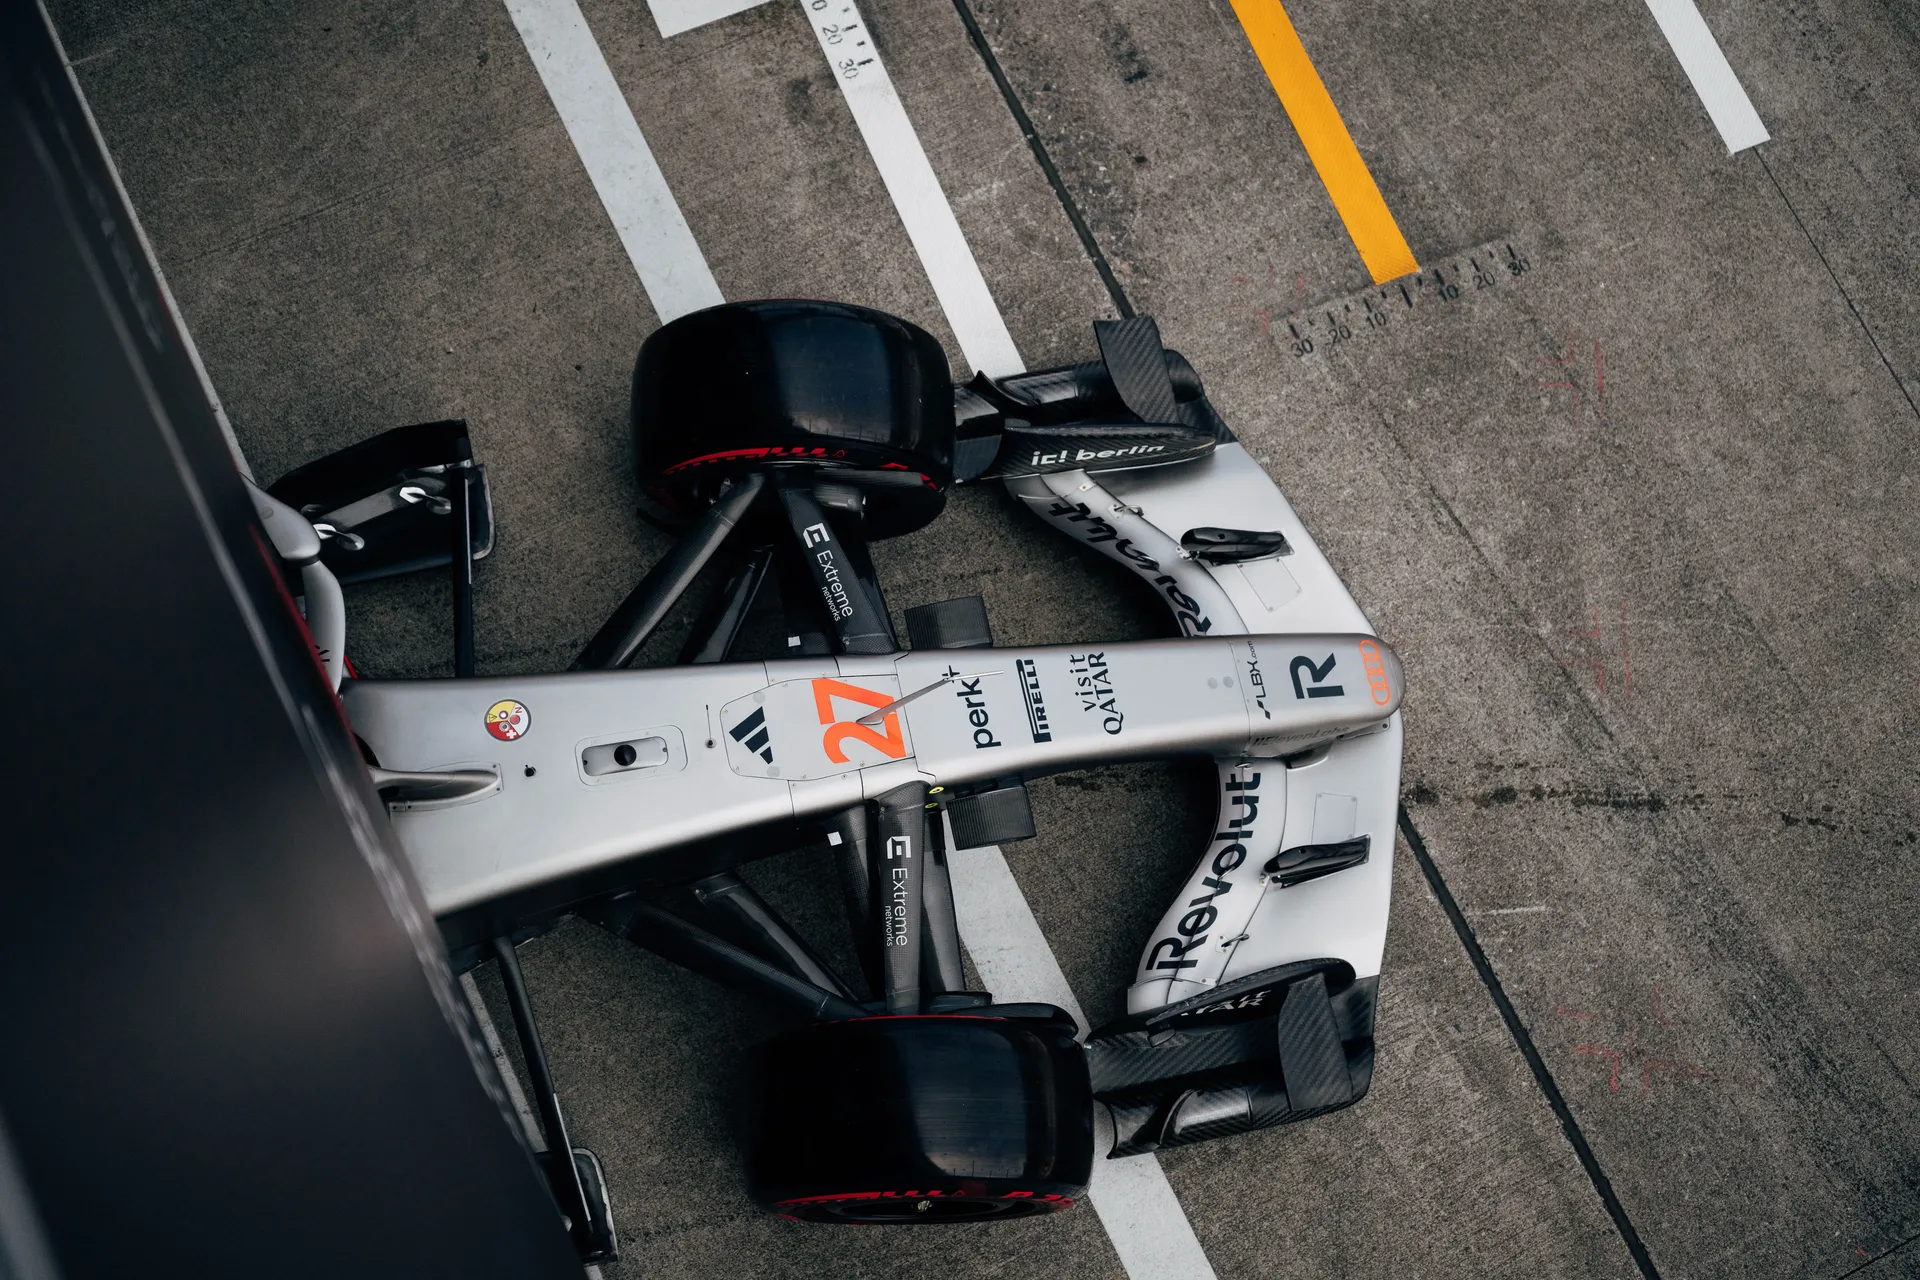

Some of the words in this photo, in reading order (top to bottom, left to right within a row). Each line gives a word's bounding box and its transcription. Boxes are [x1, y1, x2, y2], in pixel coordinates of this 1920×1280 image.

[822, 24, 843, 44] 20
[838, 58, 859, 79] 30
[1290, 337, 1314, 359] 30
[1327, 324, 1351, 345] 20
[1365, 311, 1388, 331] 10
[1437, 284, 1460, 302] 10
[1473, 271, 1496, 291] 20
[1508, 257, 1532, 277] 30
[1076, 445, 1165, 461] berlin
[816, 550, 853, 618] Extreme
[821, 585, 841, 622] networks
[1048, 502, 1212, 638] Revolut
[956, 677, 1002, 749] perk
[1015, 658, 1052, 744] PIRELLI
[1069, 654, 1097, 712] visit
[1087, 651, 1124, 735] QATAR
[811, 677, 907, 765] 27
[892, 867, 909, 946] Extreme
[1145, 772, 1261, 971] Revolut
[884, 905, 893, 947] networks
